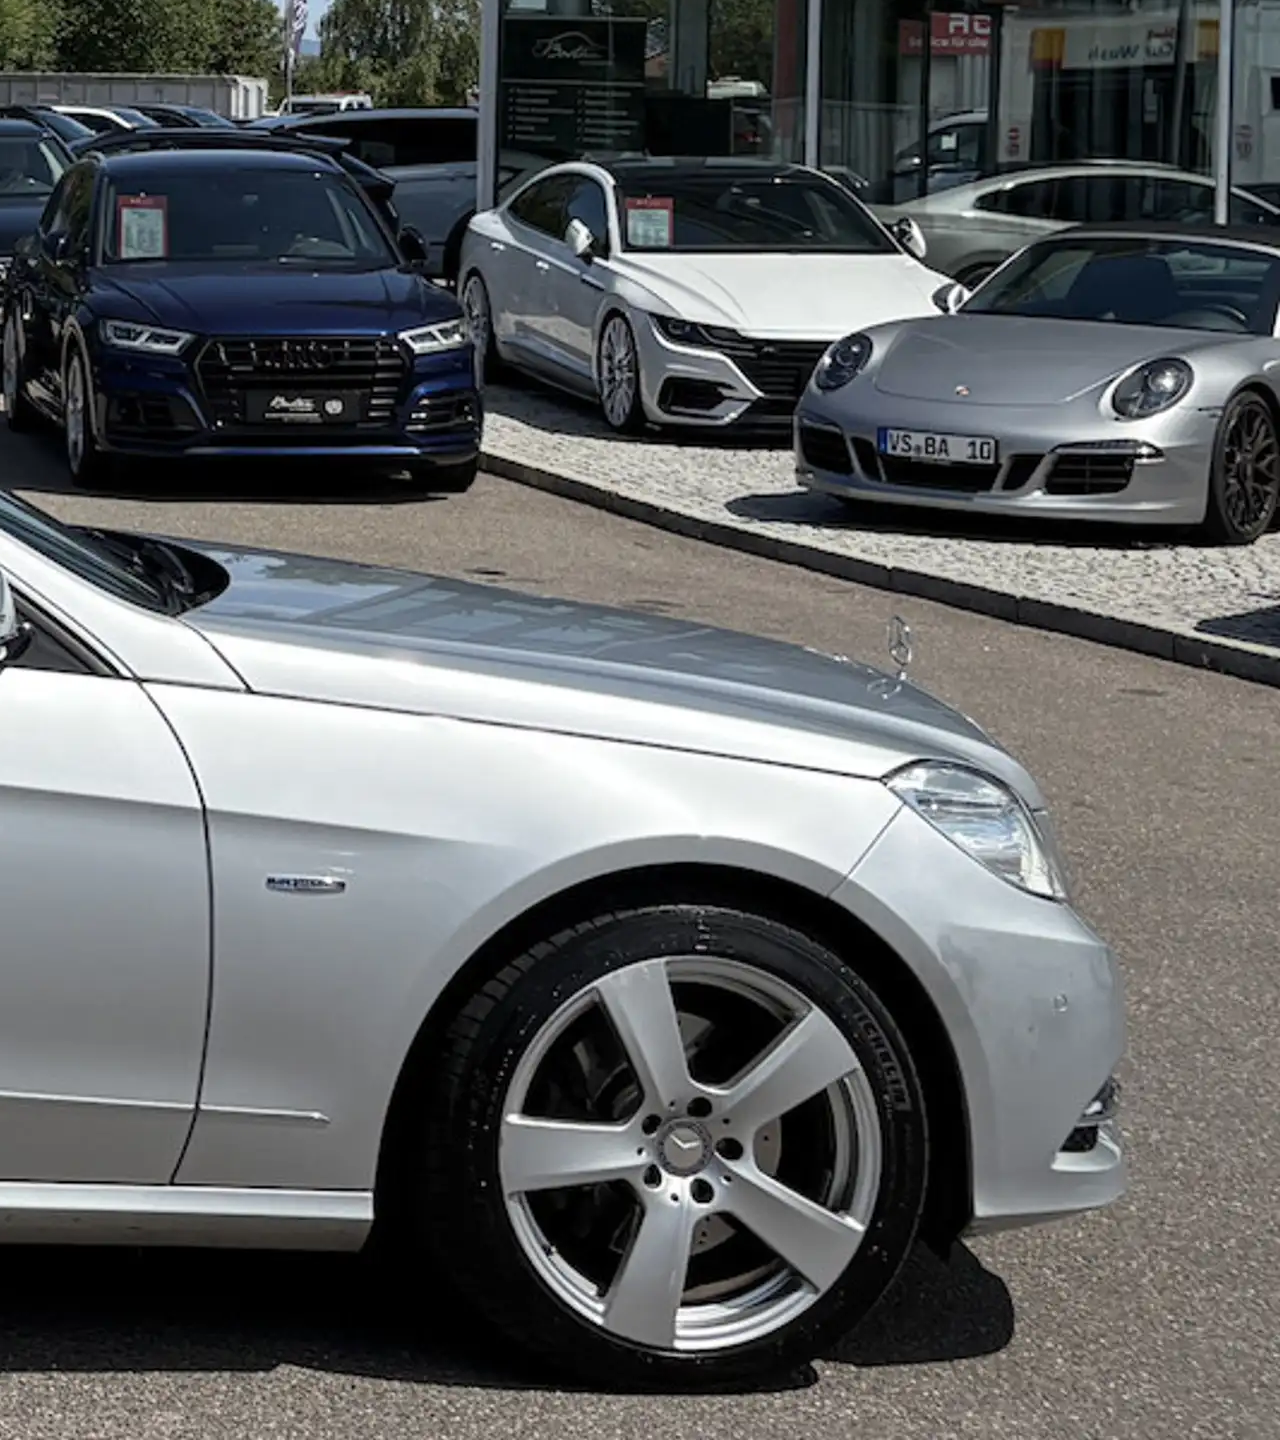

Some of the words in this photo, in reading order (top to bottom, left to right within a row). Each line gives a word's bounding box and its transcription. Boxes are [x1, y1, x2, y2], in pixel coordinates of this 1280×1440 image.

[888, 433, 912, 453] VS
[924, 436, 950, 457] BA
[965, 440, 992, 460] 10
